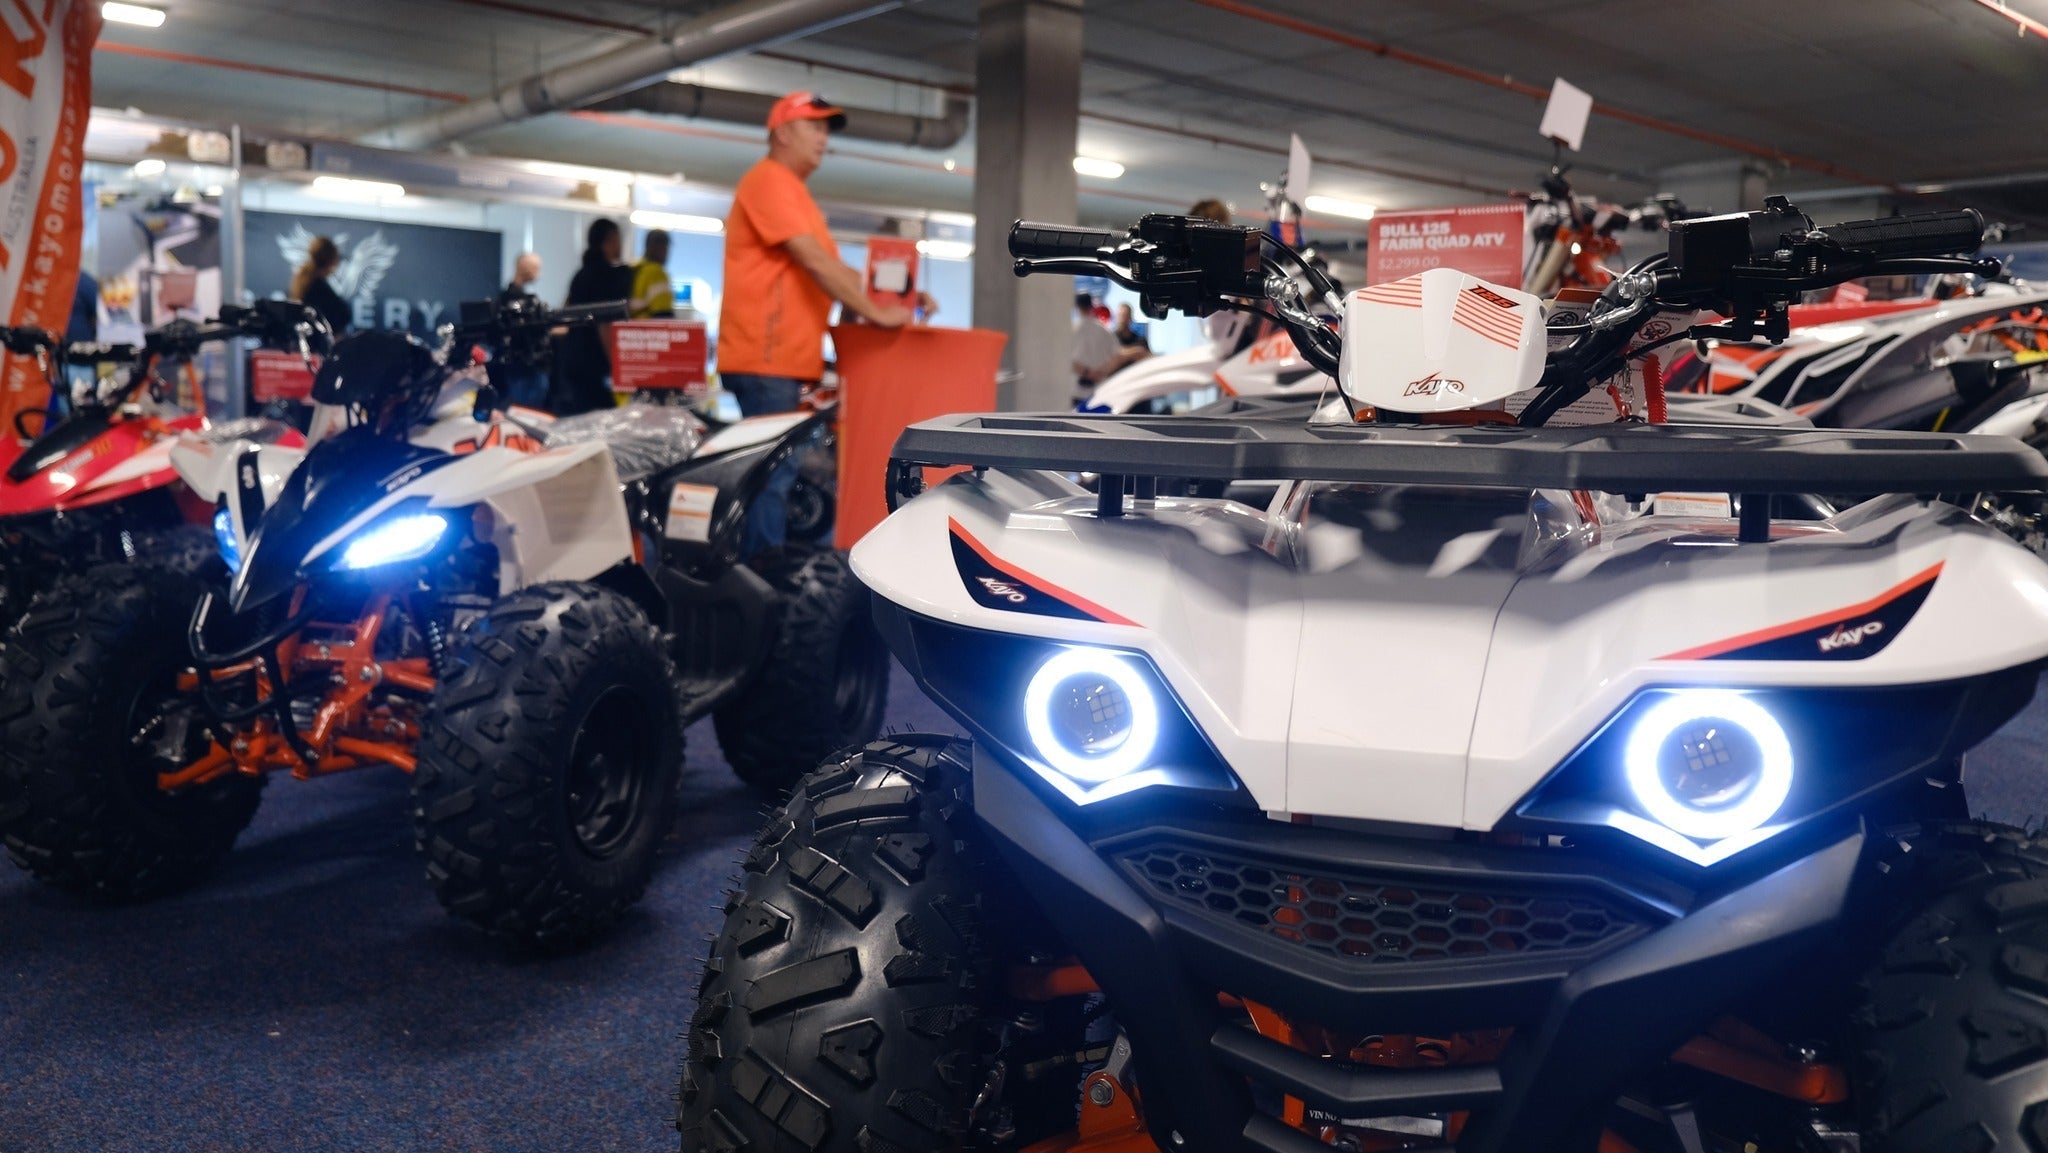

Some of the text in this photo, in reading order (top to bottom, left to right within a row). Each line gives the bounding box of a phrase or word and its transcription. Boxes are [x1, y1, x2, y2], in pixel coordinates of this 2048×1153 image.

[1379, 221, 1450, 237] BULL 125
[1379, 233, 1505, 251] FARM QUAD ATV
[1403, 371, 1464, 396] KAYO
[975, 576, 1028, 603] KAYO
[1816, 621, 1885, 653] KAYO
[1309, 1109, 1324, 1120] VIN
